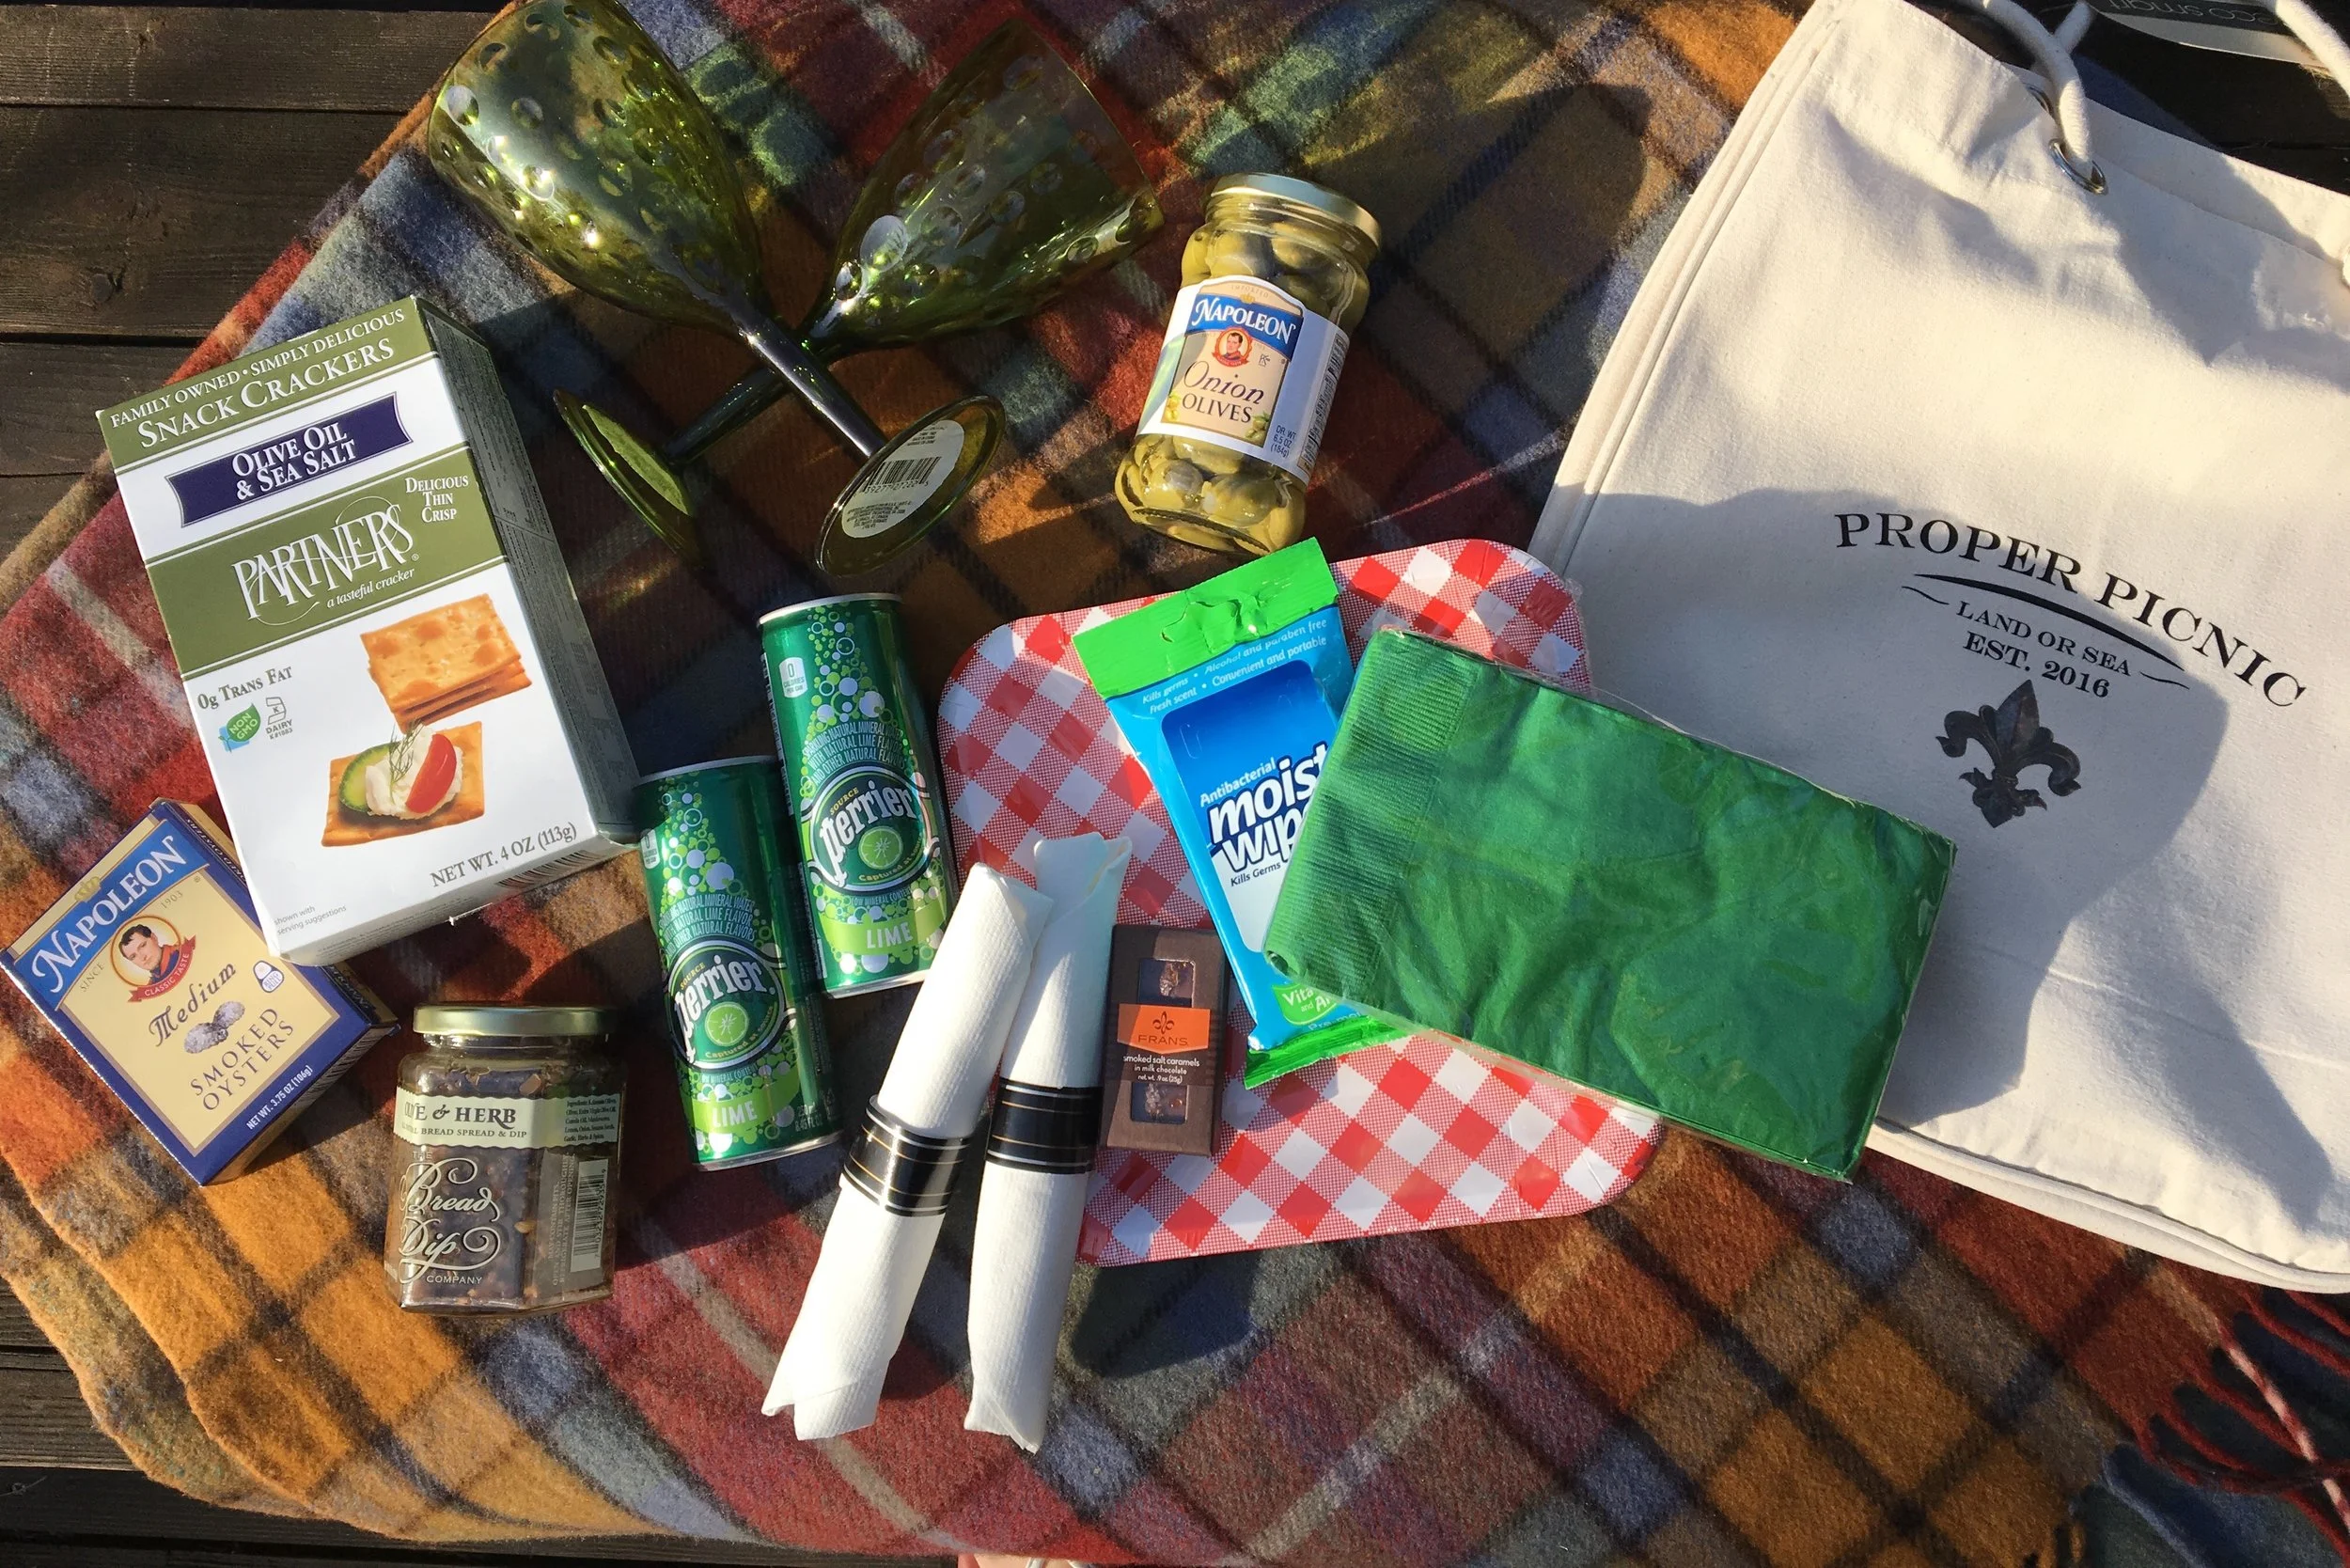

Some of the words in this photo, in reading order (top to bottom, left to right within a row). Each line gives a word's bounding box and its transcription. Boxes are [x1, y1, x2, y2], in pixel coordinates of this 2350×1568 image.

[1191, 298, 1297, 344] NAPOLEON
[110, 394, 171, 429] FAMILY
[174, 370, 242, 403] OWNED
[250, 344, 309, 376] SIMPLY
[312, 308, 405, 354] DELICIOUS
[1183, 361, 1264, 405] Onion
[137, 395, 240, 448] SNACK
[241, 337, 395, 408] CRACKERS
[1182, 393, 1253, 424] OLIVES
[232, 438, 302, 477] OLIVE
[303, 422, 348, 450] OIL
[1271, 444, 1291, 459] (184g)
[236, 479, 255, 501] &
[257, 467, 303, 493] SEA
[303, 439, 357, 475] SALT
[405, 475, 469, 494] DELICIOUS
[421, 508, 457, 523] CRISP
[422, 491, 453, 508] THIN
[231, 502, 414, 622] PARTNERS
[327, 599, 336, 608] a
[336, 582, 373, 607] tasteful
[375, 569, 415, 590] cracker
[1835, 512, 2081, 594] PROPER
[2093, 572, 2307, 707] PICNIC
[1956, 601, 2031, 638] LAND
[2038, 631, 2076, 656] OR
[2082, 646, 2131, 677] SEA
[1142, 690, 1162, 705] Kills
[1163, 677, 1189, 698] germs
[1204, 651, 1242, 675] Alcohol
[1243, 643, 1262, 658] and
[1264, 627, 1307, 651] paraben
[1308, 619, 1327, 635] free
[1174, 687, 1198, 705] scent
[1212, 659, 1265, 687] Convenient
[1266, 651, 1286, 665] and
[1287, 635, 1327, 660] portable
[1963, 631, 2030, 672] EST.
[2042, 660, 2110, 698] 2016
[197, 693, 219, 710] 0g
[218, 677, 264, 701] TRANS
[265, 666, 292, 685] FAT
[228, 713, 252, 734] NON
[236, 718, 258, 740] GMO
[265, 719, 292, 734] DAIRY
[802, 731, 831, 760] SPARKLING
[829, 724, 857, 740] NATURAL
[858, 721, 885, 735] MINERAL
[807, 753, 825, 770] WITH
[823, 735, 857, 756] NATURAL
[859, 734, 876, 747] LIME
[811, 768, 825, 786] AND
[824, 755, 846, 774] OTHER
[845, 747, 877, 762] NATURAL
[829, 787, 859, 815] SOURCE
[1199, 757, 1277, 808] Antibacterial
[1209, 744, 1327, 844] moist
[1222, 799, 1310, 872] wip
[430, 862, 466, 887] NET
[467, 850, 499, 872] WT.
[500, 846, 510, 861] 4
[510, 837, 536, 856] OZ
[538, 822, 578, 851] (113g)
[858, 866, 900, 882] Captured
[1230, 873, 1251, 887] Kills
[1252, 862, 1281, 878] Germs
[31, 835, 187, 994] NAPOLEON
[274, 909, 300, 926] shown
[298, 904, 316, 919] with
[276, 917, 305, 936] serving
[304, 905, 348, 926] suggestions
[674, 909, 703, 934] NATURAL
[705, 907, 723, 921] LIME
[724, 908, 753, 929] FLAVOR
[678, 894, 704, 913] NATURAL
[705, 893, 732, 908] MINERAL
[734, 896, 755, 914] WATER
[80, 962, 105, 993] SINCE
[162, 890, 184, 910] 1903
[673, 929, 693, 949] OTHER
[693, 920, 724, 935] NATURAL
[725, 919, 758, 941] FLAVORS
[867, 922, 913, 949] LIME
[144, 977, 176, 996] CLASSIC
[175, 952, 190, 980] TASTE
[680, 962, 706, 990] SOURCE
[149, 964, 237, 1047] Medium
[1301, 1002, 1314, 1012] and
[190, 1008, 279, 1096] SMOKED
[705, 1040, 748, 1058] Captured
[1138, 1035, 1188, 1046] FRANS
[202, 1020, 293, 1111] OYSTERS
[1122, 1054, 1152, 1063] smoked
[1152, 1056, 1166, 1064] salt
[1167, 1058, 1200, 1067] caramels
[1142, 1064, 1155, 1073] milk
[1156, 1065, 1187, 1074] chocolate
[246, 1114, 260, 1130] NET
[258, 1105, 274, 1120] WT.
[270, 1091, 287, 1107] 3.75
[284, 1082, 295, 1095] OZ
[292, 1064, 314, 1088] (106g)
[713, 1102, 758, 1128] LIME
[421, 1127, 454, 1136] BREAD
[457, 1129, 494, 1137] SPREAD
[432, 1104, 450, 1120] &
[455, 1106, 516, 1130] HERB
[413, 1151, 432, 1159] THE
[400, 1157, 500, 1222] Bread
[399, 1216, 500, 1284] Dip
[427, 1275, 482, 1284] COMPANY
